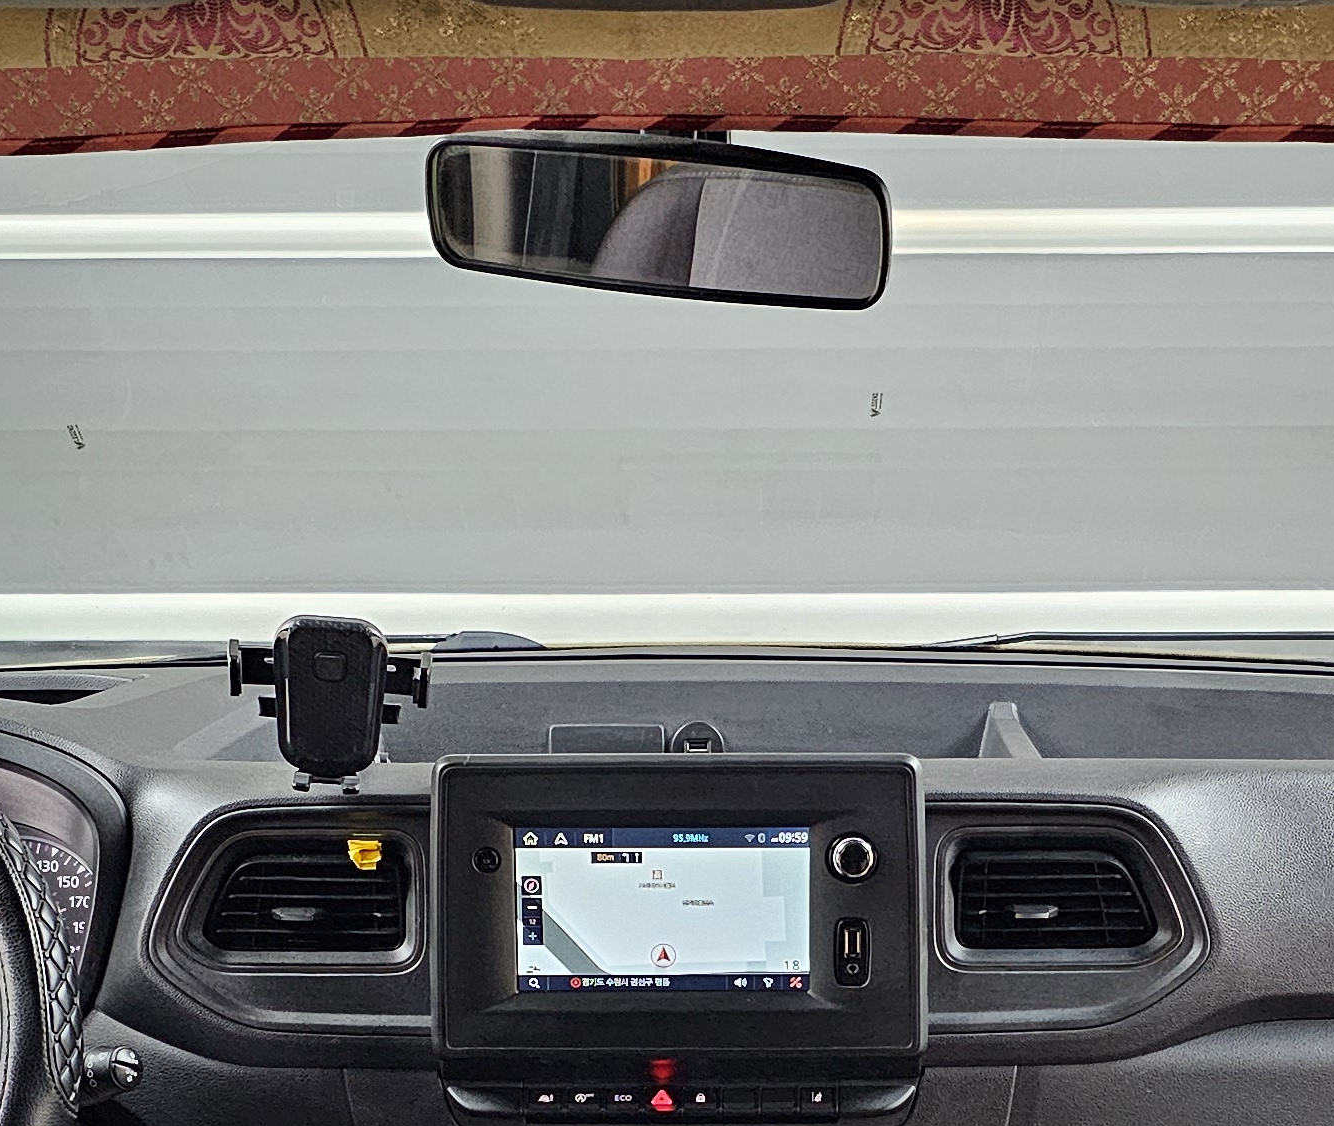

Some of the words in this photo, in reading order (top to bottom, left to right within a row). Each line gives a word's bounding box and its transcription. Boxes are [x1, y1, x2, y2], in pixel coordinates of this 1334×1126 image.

[583, 833, 604, 844] FM1
[778, 831, 809, 844] 09:59
[596, 852, 615, 863] 80m
[36, 860, 59, 873] 130
[57, 876, 80, 889] 150
[614, 1094, 633, 1102] ECO
